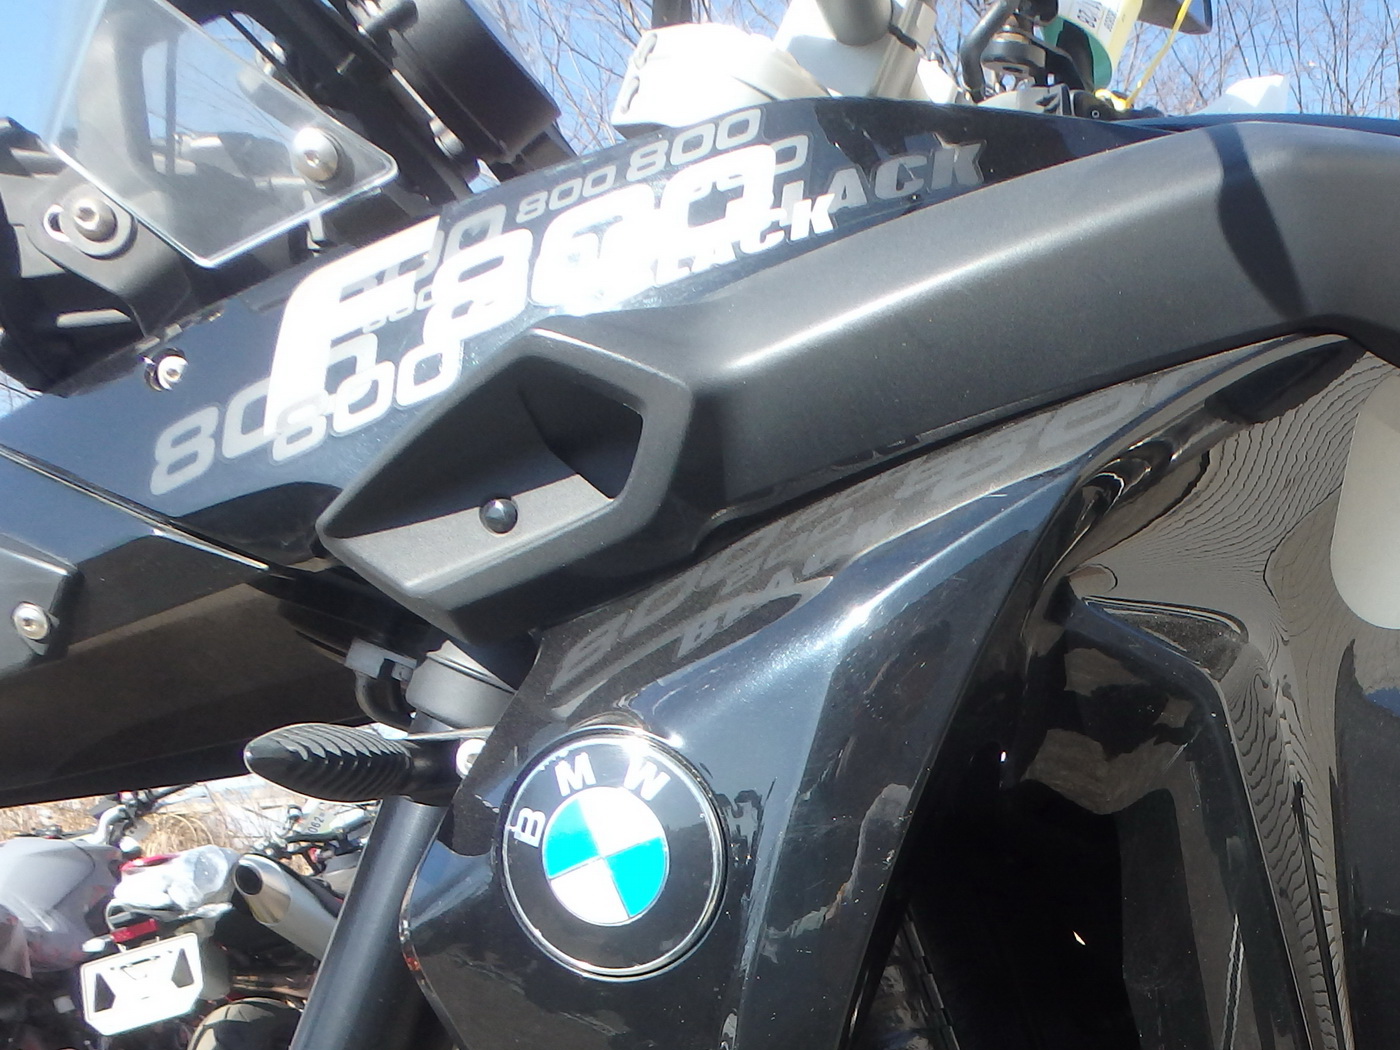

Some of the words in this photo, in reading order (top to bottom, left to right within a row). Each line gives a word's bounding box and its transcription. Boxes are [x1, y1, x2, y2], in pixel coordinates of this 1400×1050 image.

[515, 165, 617, 224] 800
[625, 107, 763, 183] 800
[779, 141, 988, 227] LACK
[513, 751, 671, 849] BMW
